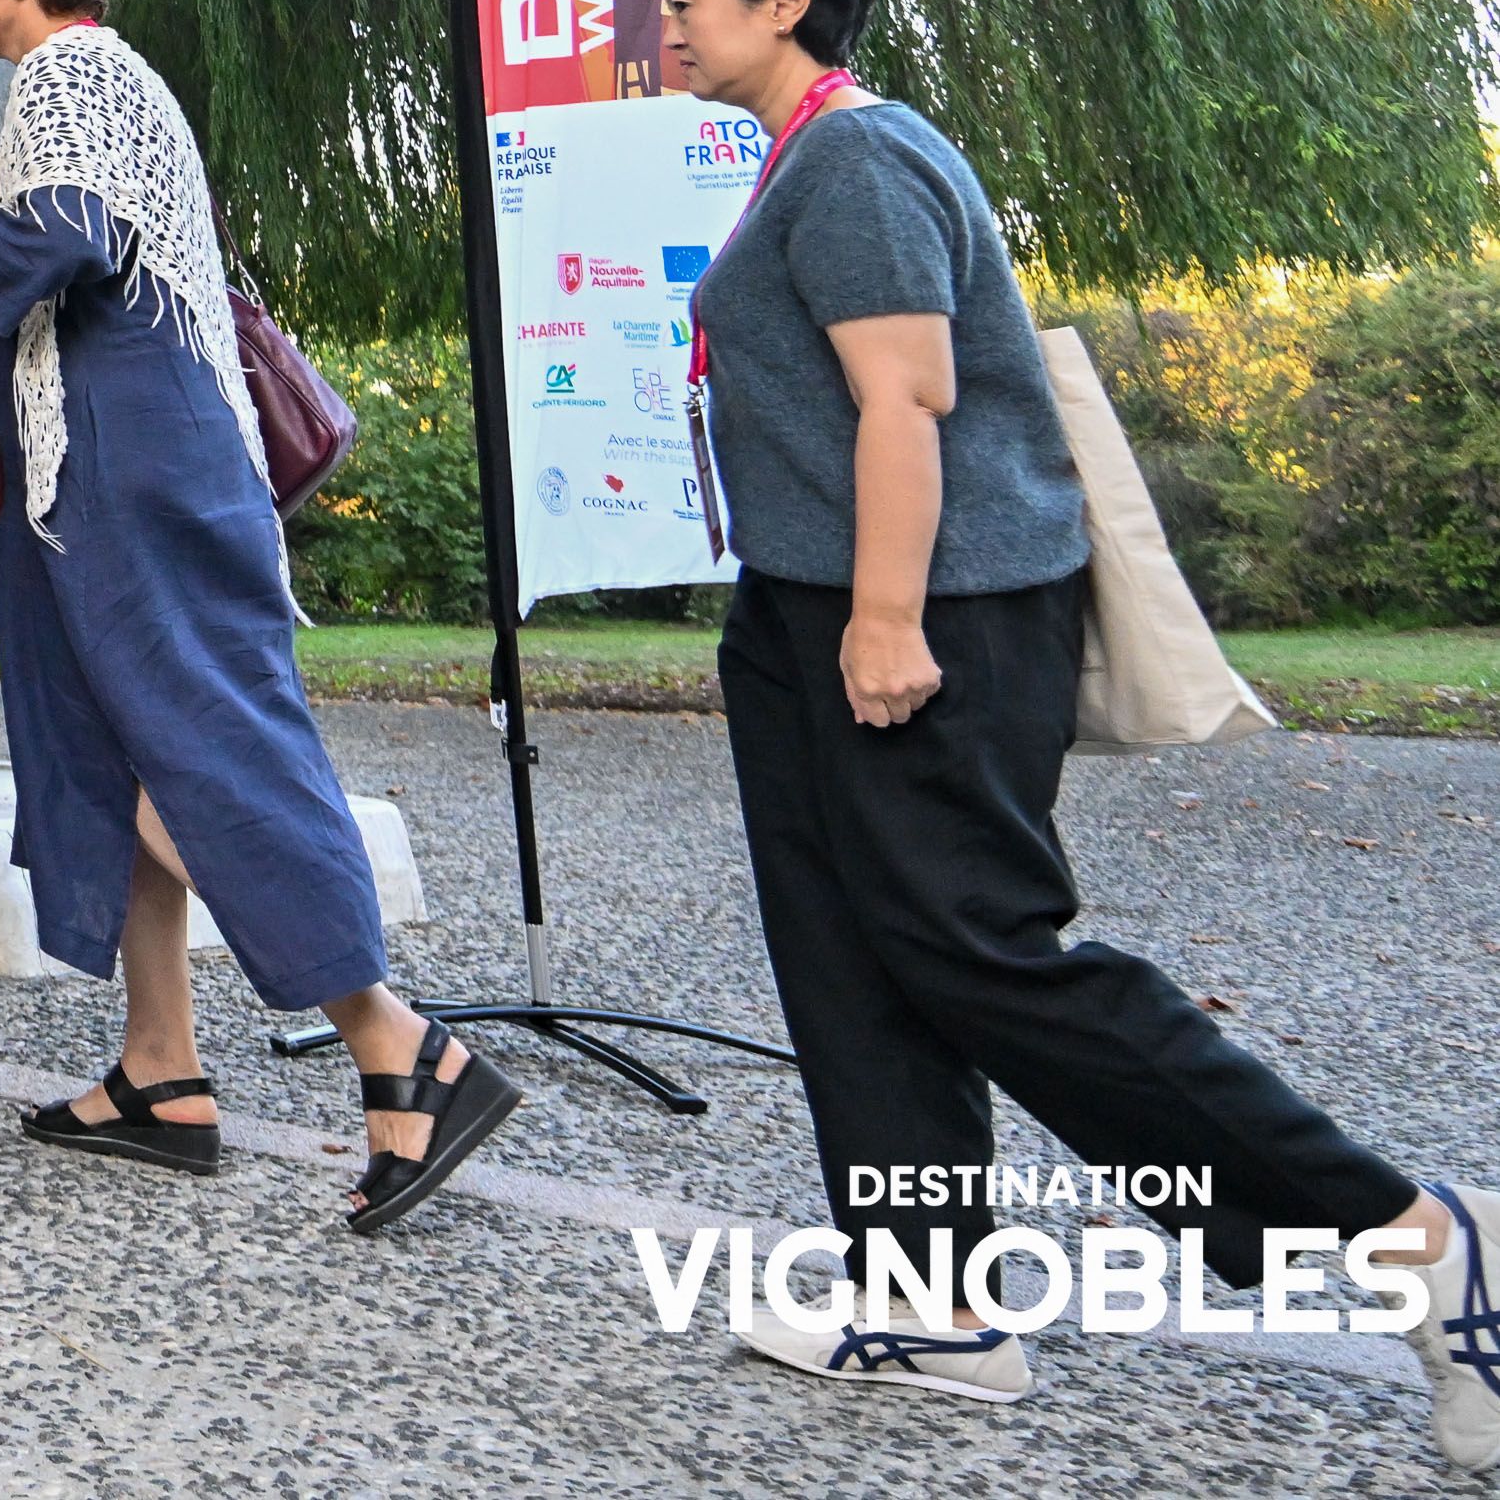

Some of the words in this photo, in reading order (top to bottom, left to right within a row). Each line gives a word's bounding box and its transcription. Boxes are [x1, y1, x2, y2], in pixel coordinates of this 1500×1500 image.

[700, 119, 758, 142] ATO
[684, 141, 763, 166] FRAN
[590, 265, 644, 276] Nouvelle-
[592, 278, 646, 289] Aquitaine
[613, 320, 622, 331] La
[624, 321, 661, 331] Charente
[624, 331, 660, 342] Maritime
[608, 434, 643, 447] Avec
[646, 435, 658, 448] le
[660, 438, 694, 451] soutie
[602, 448, 640, 461] With
[644, 451, 668, 463] the
[669, 453, 696, 467] supp
[582, 496, 649, 511] COGNAC
